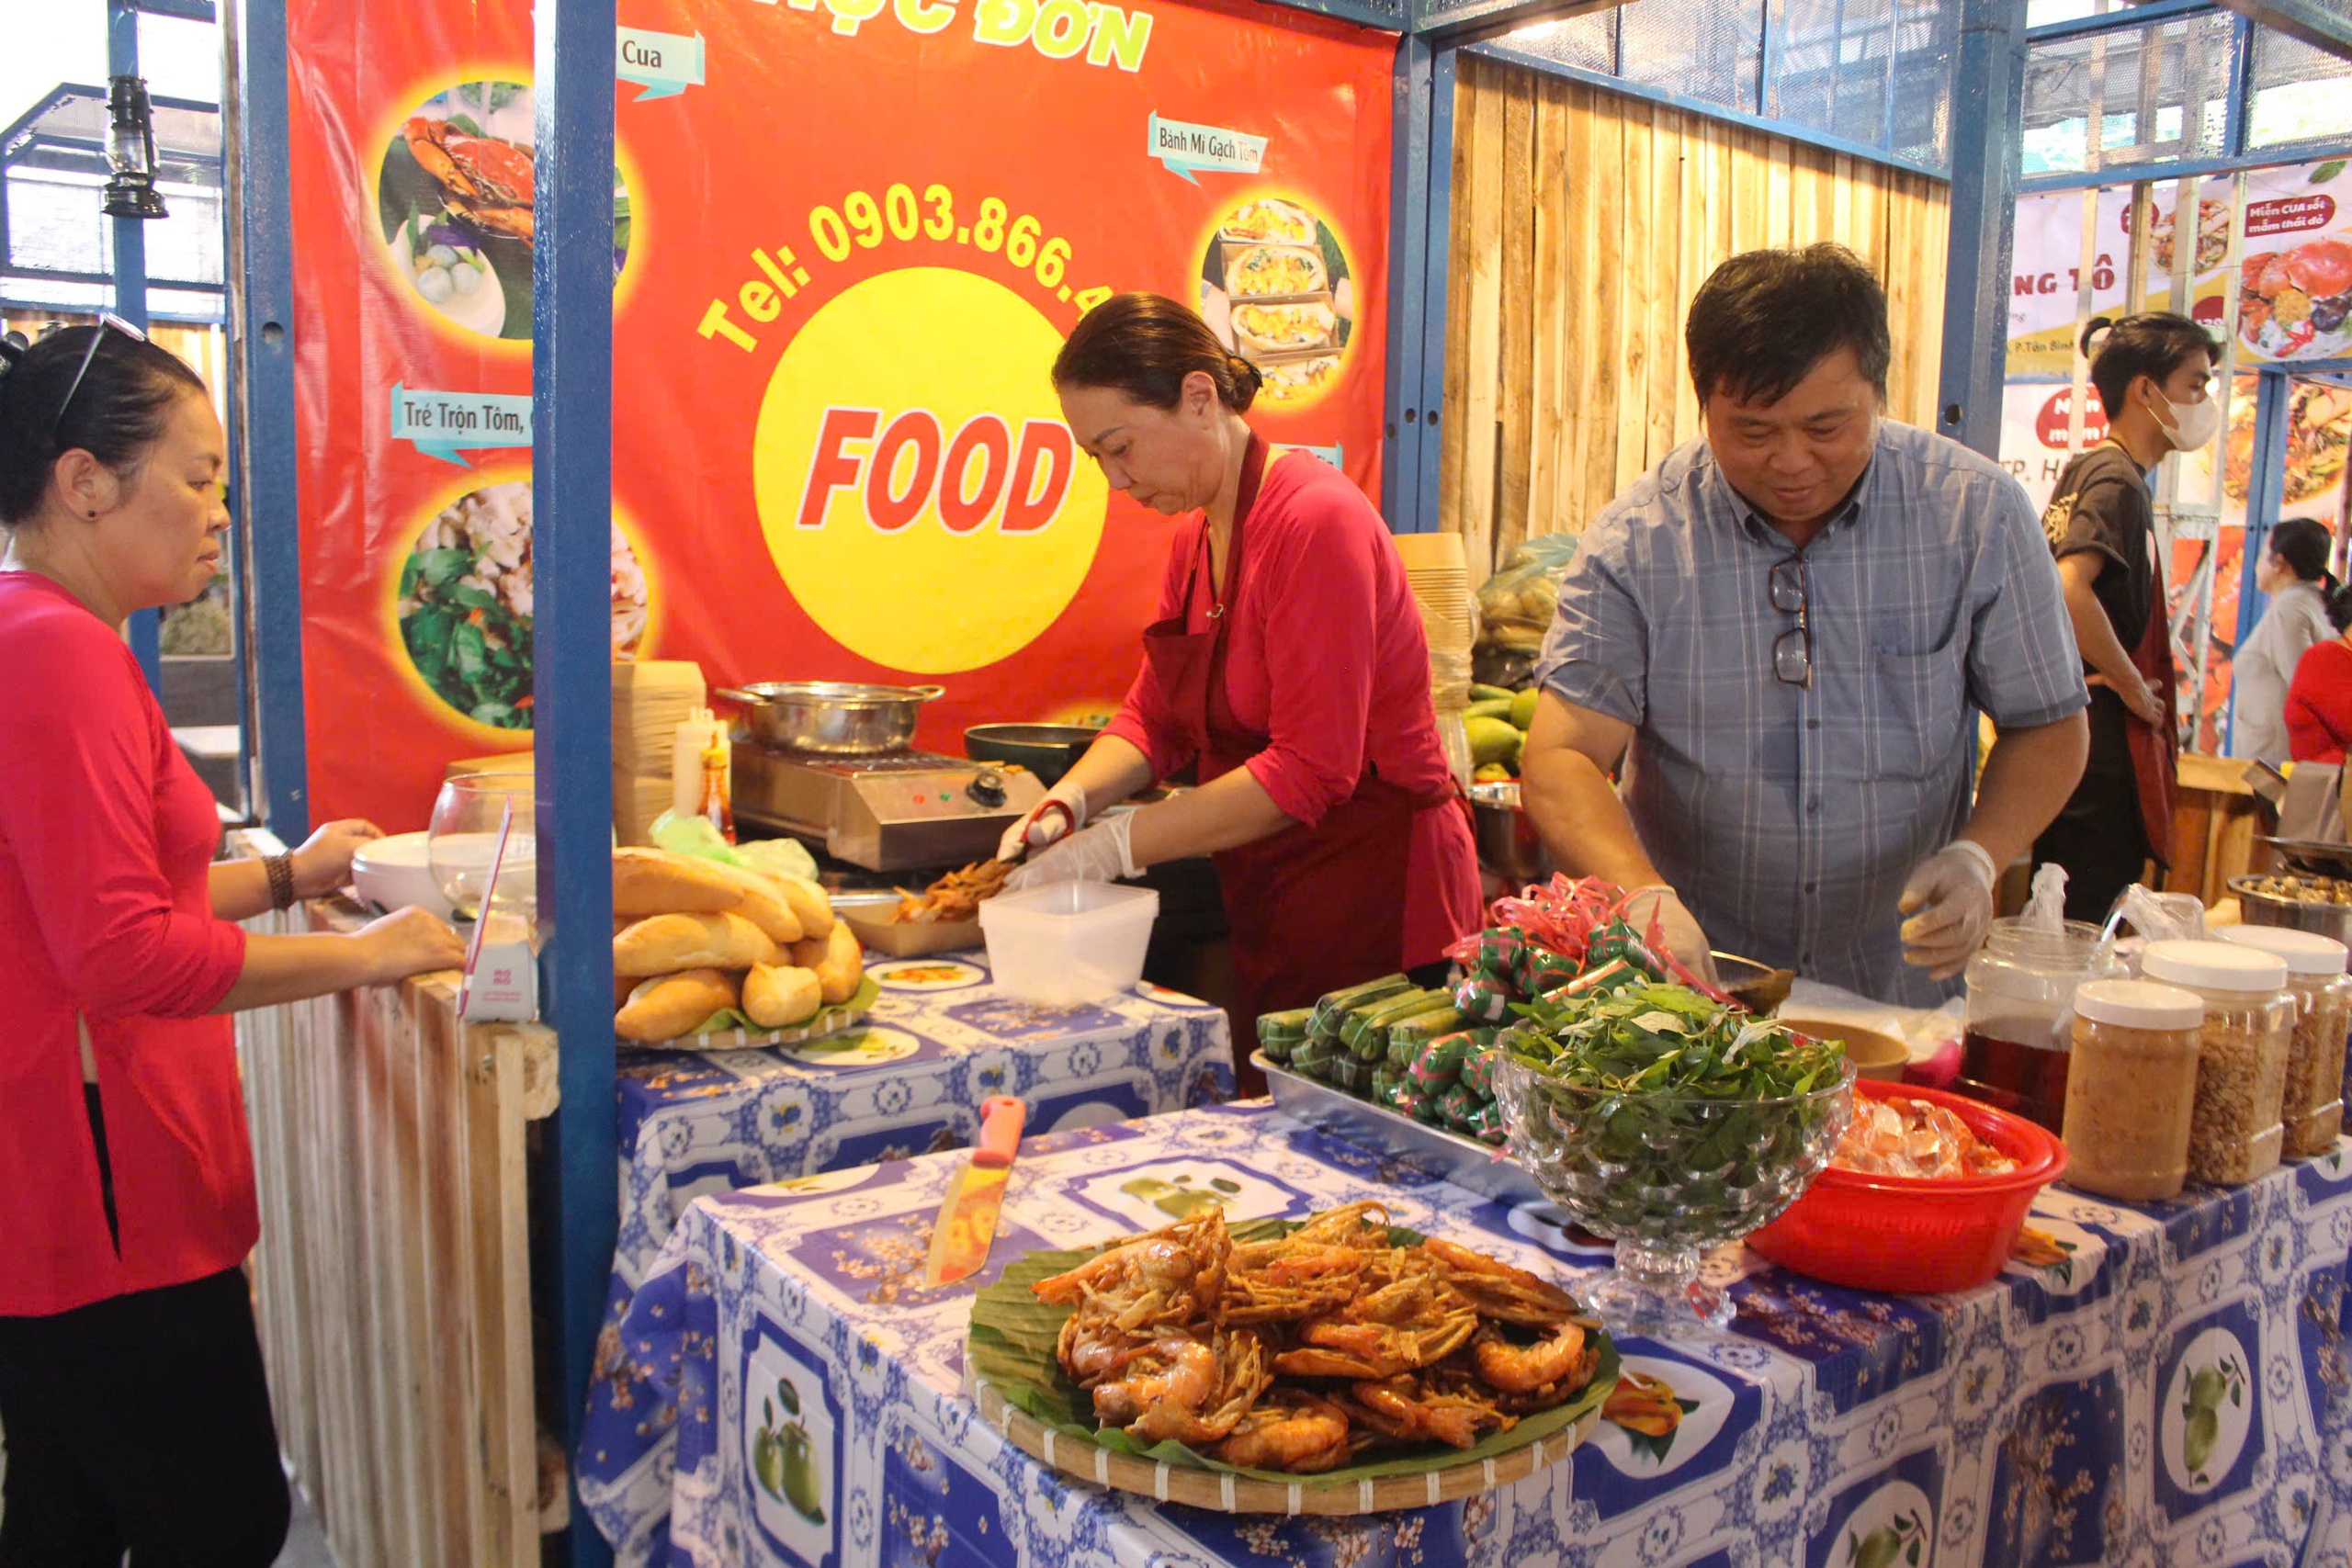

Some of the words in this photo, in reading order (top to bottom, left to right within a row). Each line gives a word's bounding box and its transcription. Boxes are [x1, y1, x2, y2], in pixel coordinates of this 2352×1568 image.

[622, 39, 662, 68] Cua
[973, 0, 1153, 73] ĐƠN
[1159, 127, 1187, 152] Bánh
[1208, 136, 1236, 162] Gạch
[2281, 203, 2306, 214] CUA
[696, 243, 812, 354] Tel:
[808, 183, 1114, 322] 0903.866.4
[2014, 273, 2057, 296] NG
[404, 401, 432, 427] Tré
[438, 403, 477, 434] Trộn
[482, 405, 524, 434] Tôm,
[795, 404, 1077, 536] FOOD
